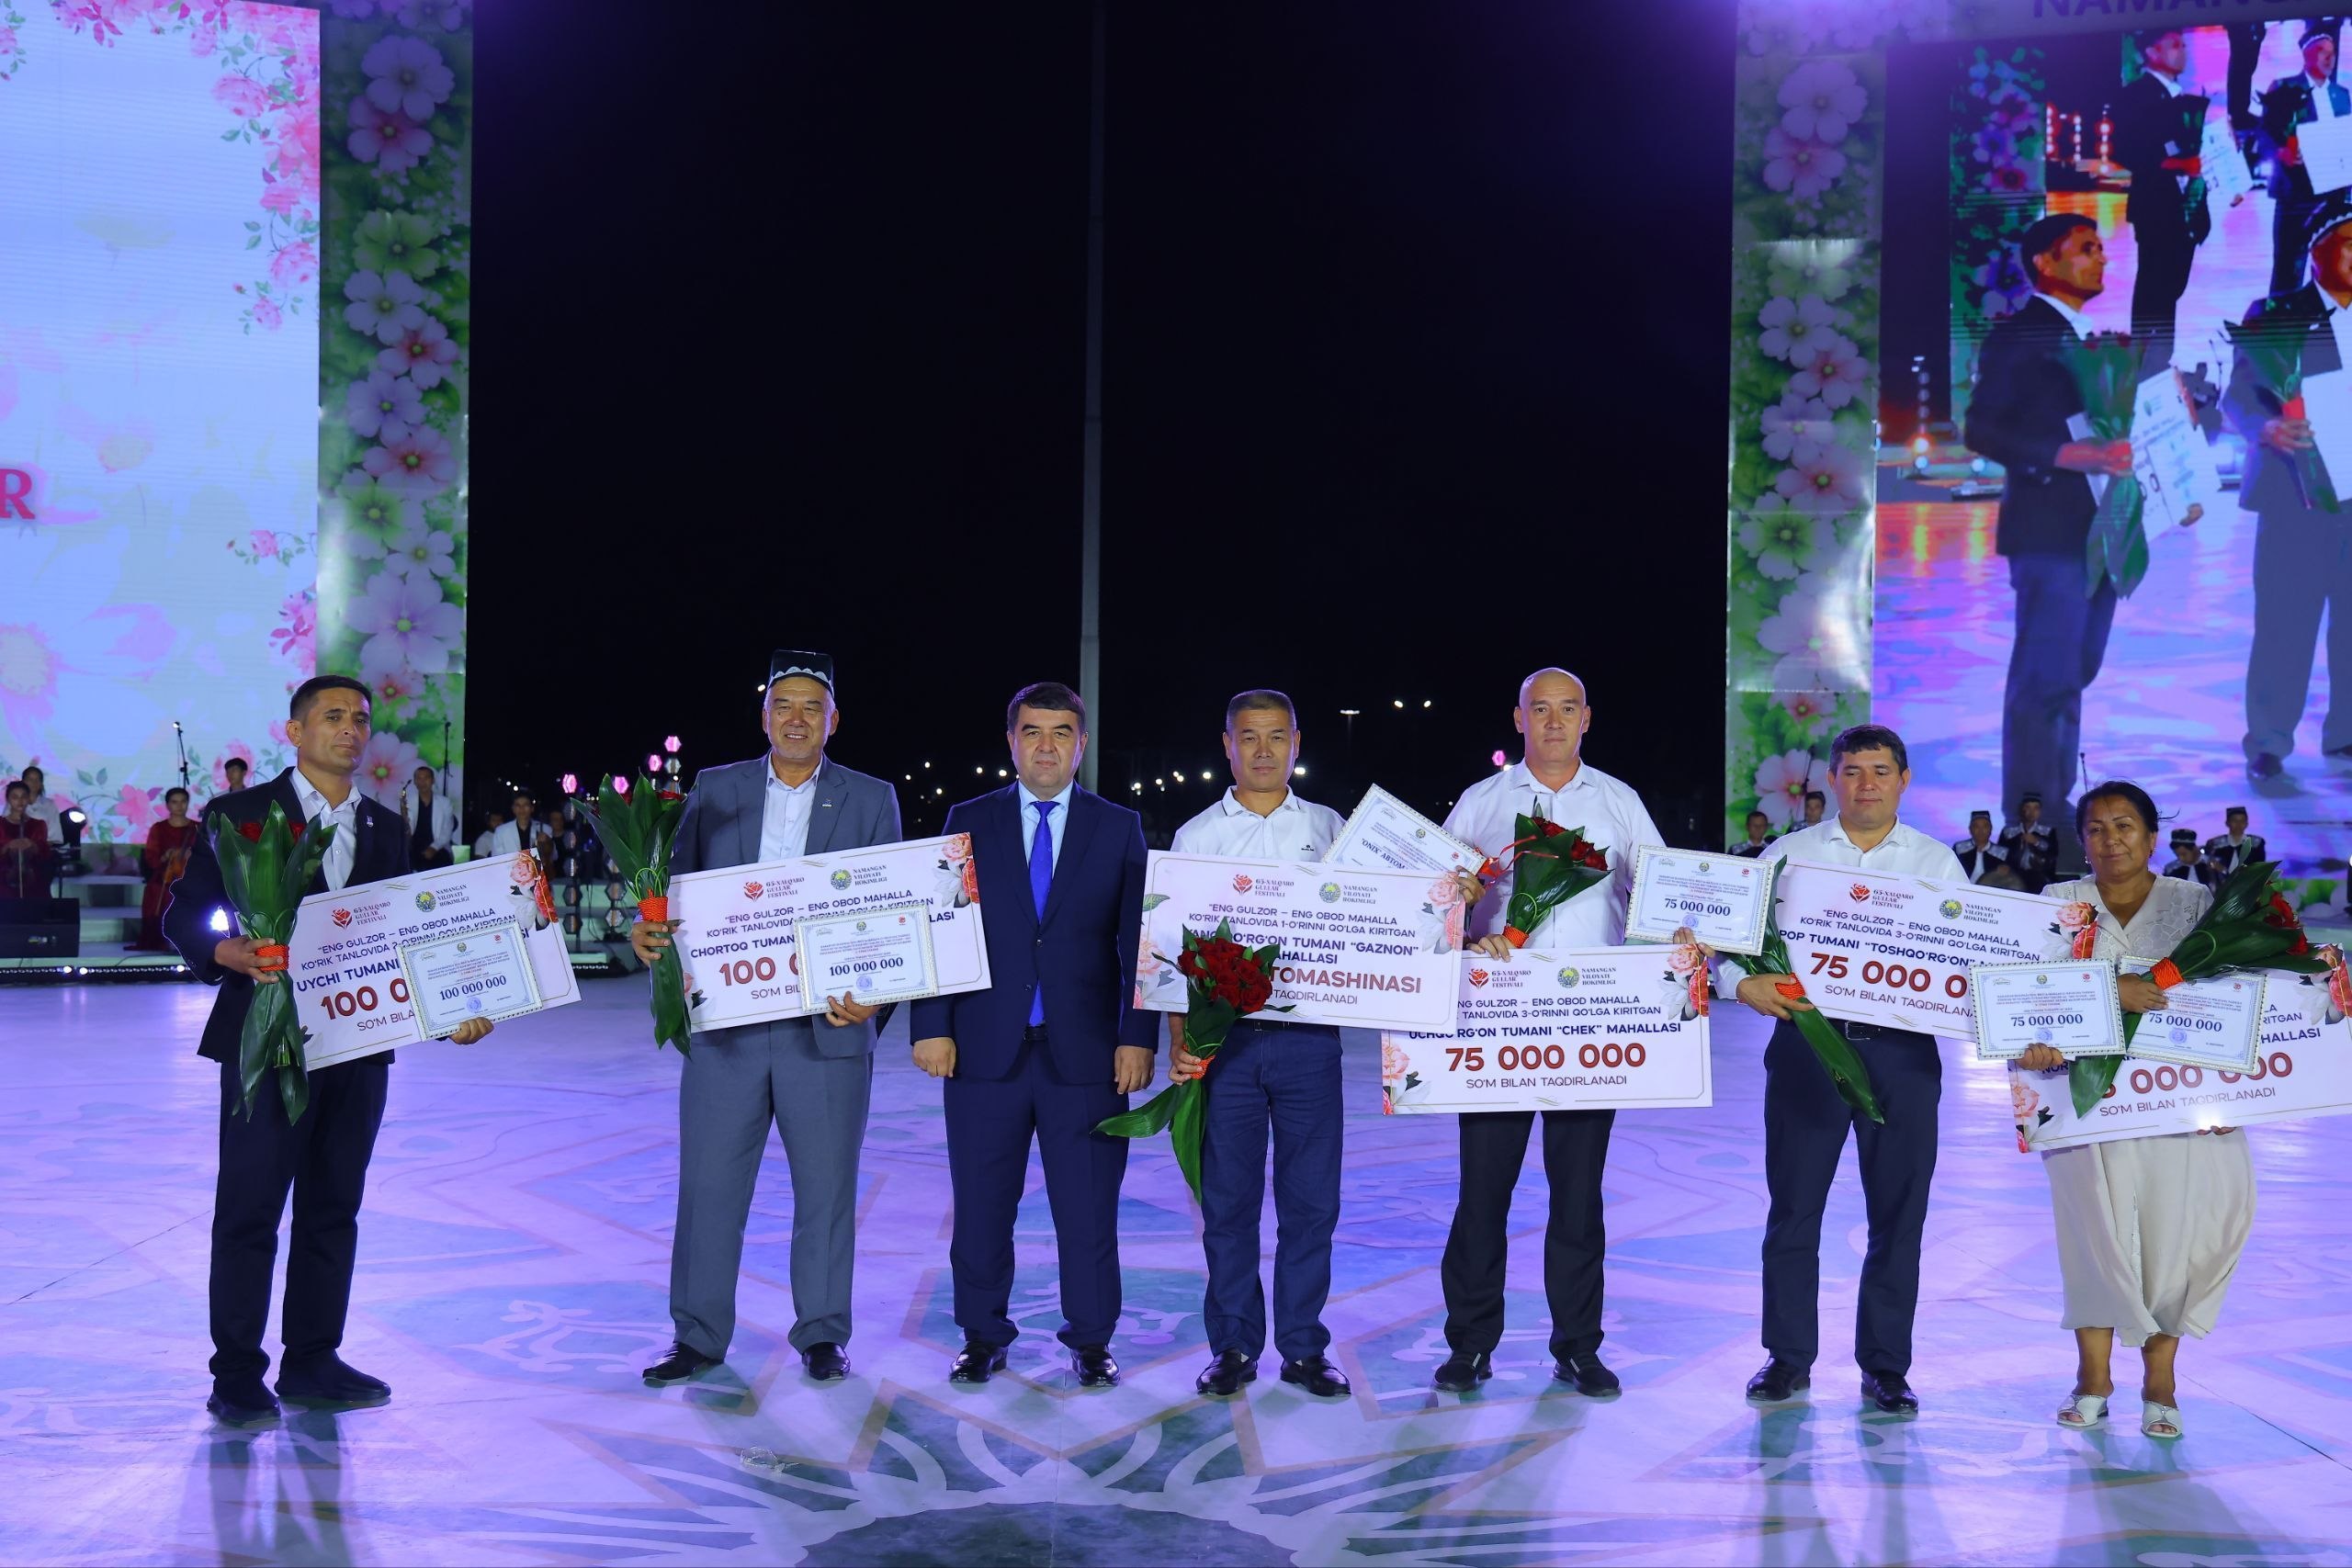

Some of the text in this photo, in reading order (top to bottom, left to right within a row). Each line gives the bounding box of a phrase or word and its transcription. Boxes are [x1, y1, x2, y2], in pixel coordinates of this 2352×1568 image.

[753, 907, 794, 919] GULZOR
[808, 903, 829, 911] ENG
[832, 897, 861, 908] OBOD
[864, 890, 912, 904] MAHALLA
[1237, 906, 1277, 916] GULZOR
[1292, 909, 1313, 919] ENG
[1316, 911, 1345, 921] OBOD
[1349, 914, 1397, 925] MAHALLA
[1665, 897, 1731, 916] 75 000 000
[346, 932, 386, 948] GULZOR
[399, 925, 419, 936] ENG
[422, 918, 448, 931] OBOD
[451, 908, 496, 925] MAHALLA
[707, 926, 738, 937] KO'RIK
[1190, 913, 1220, 922] KO'RIK
[1282, 920, 1325, 931] 1-O'RINNI
[1329, 924, 1365, 934] QO'LGA
[1369, 927, 1416, 937] KIRITGAN
[1851, 913, 1894, 927] GULZOR
[1909, 921, 1931, 932] ENG
[1934, 925, 1964, 938] OBOD
[1968, 931, 2019, 947] MAHALLA
[691, 934, 795, 957] CHORTOQ TUMAN
[1293, 937, 1345, 950] TUMANI
[1351, 942, 1419, 955] "GAZNON"
[1780, 930, 1975, 966] POP TUMANI "TOSHQO'RG'ON"
[1800, 917, 2040, 961] KO'RIK TANLOVIDA 3-O'RINNI QO'LGA KIRITGAN
[301, 957, 334, 971] KO'RIK
[336, 944, 390, 962] TANLOVIDA
[830, 957, 903, 976] 100 000 000
[297, 958, 400, 991] UYCHI TUMANI
[719, 957, 775, 987] 100
[1270, 966, 1421, 993] TOMASHINASI
[1810, 952, 1849, 978] 75
[1862, 960, 1931, 992] 000
[439, 975, 507, 1000] 100 000 000
[752, 984, 801, 999] SO'M BIL
[1273, 989, 1357, 1004] TAQDIRLANADI
[321, 986, 379, 1020] 100
[1463, 1006, 1661, 1019] TANLOVIDA 3-O'RINNI QO'LGA KIRITGAN
[1476, 999, 1517, 1008] GULZOR
[1532, 998, 1554, 1006] ENG
[1557, 997, 1587, 1006] OBOD
[1590, 996, 1640, 1005] MAHALLA
[1826, 985, 1973, 1018] SO'M BILAN TAQDIRLAN
[357, 1010, 414, 1032] SO'M BILA
[1500, 1026, 1552, 1037] TUMANI
[1556, 1024, 1602, 1035] "CHEK"
[1607, 1023, 1680, 1034] MAHALLASI
[2010, 1014, 2083, 1026] 75 000 000
[2149, 1013, 2222, 1032] 75 000 000
[2260, 1028, 2320, 1043] HALLASI
[1445, 1043, 1645, 1072] 75 000 000
[1466, 1076, 1627, 1089] SO'M BILAN TAQDIRLANADI
[2131, 1066, 2202, 1094] 000
[2100, 1088, 2276, 1116] SO'M BILAN TAQDIRLANADI
